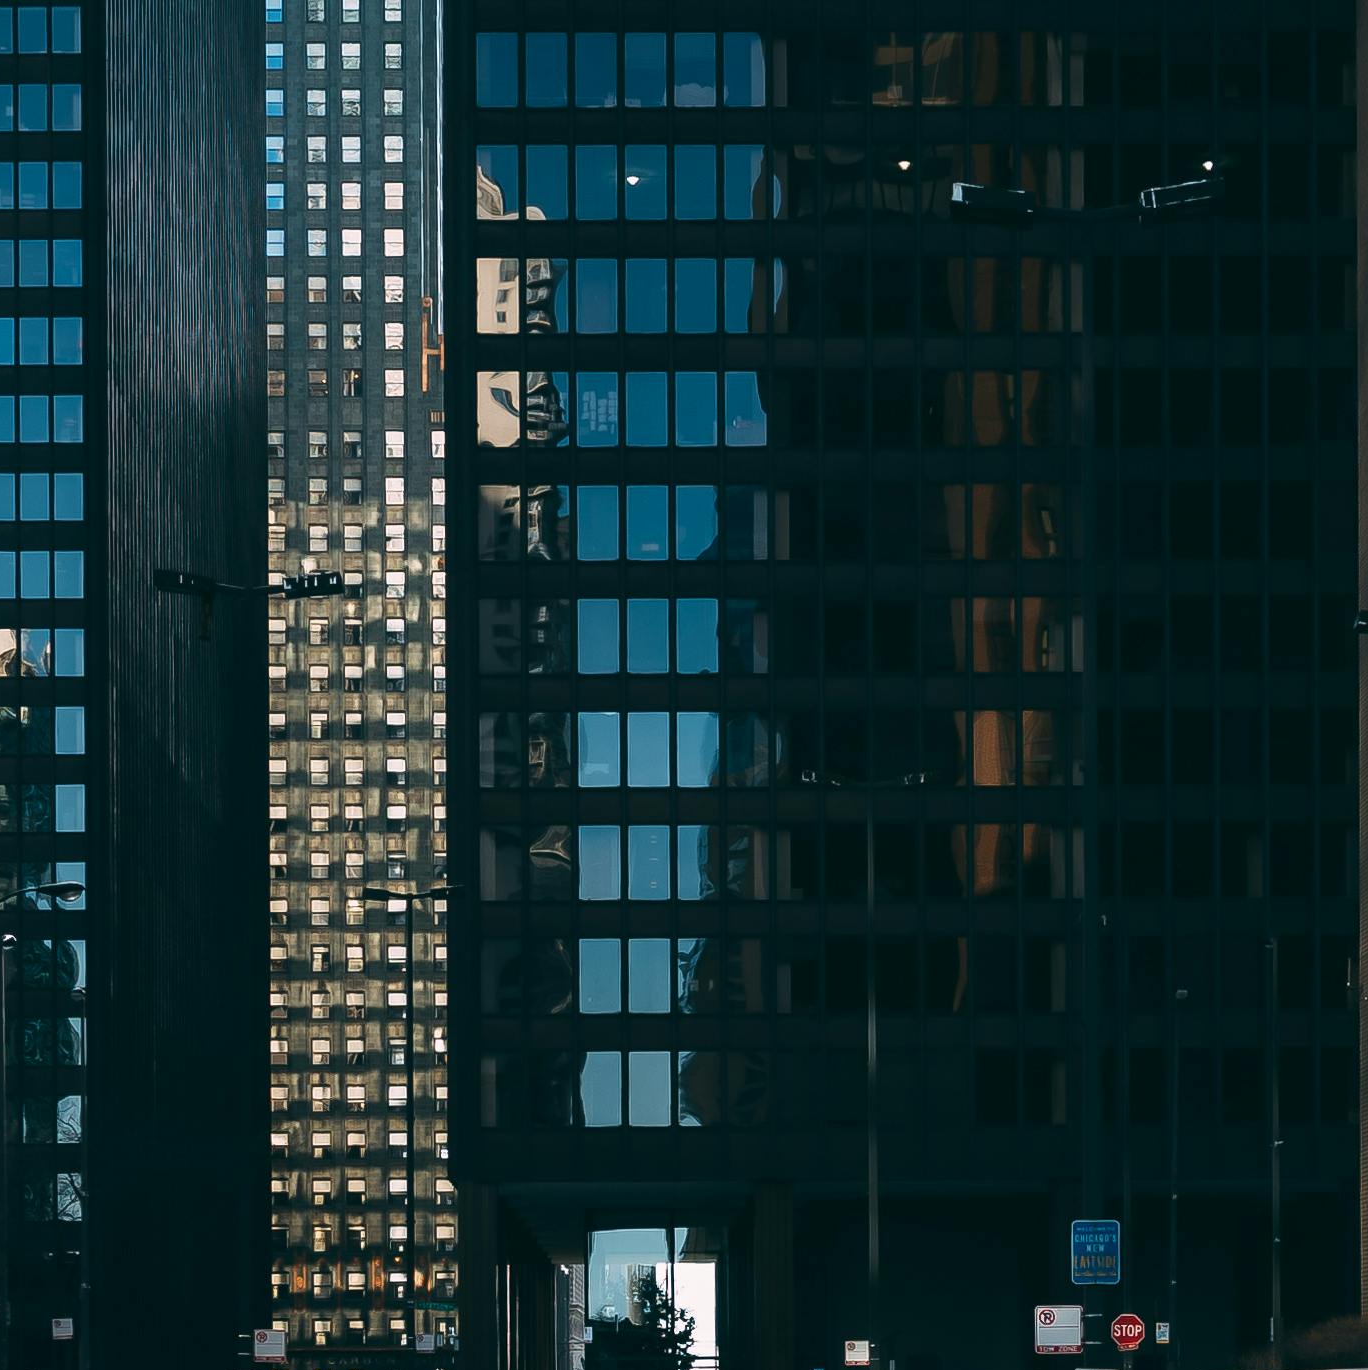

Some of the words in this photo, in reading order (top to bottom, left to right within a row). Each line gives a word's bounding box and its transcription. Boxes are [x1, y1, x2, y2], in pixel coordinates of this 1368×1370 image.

[1074, 1233, 1117, 1243] CHICAGO'S
[1086, 1243, 1105, 1252] NEW
[1113, 1324, 1142, 1337] STOP
